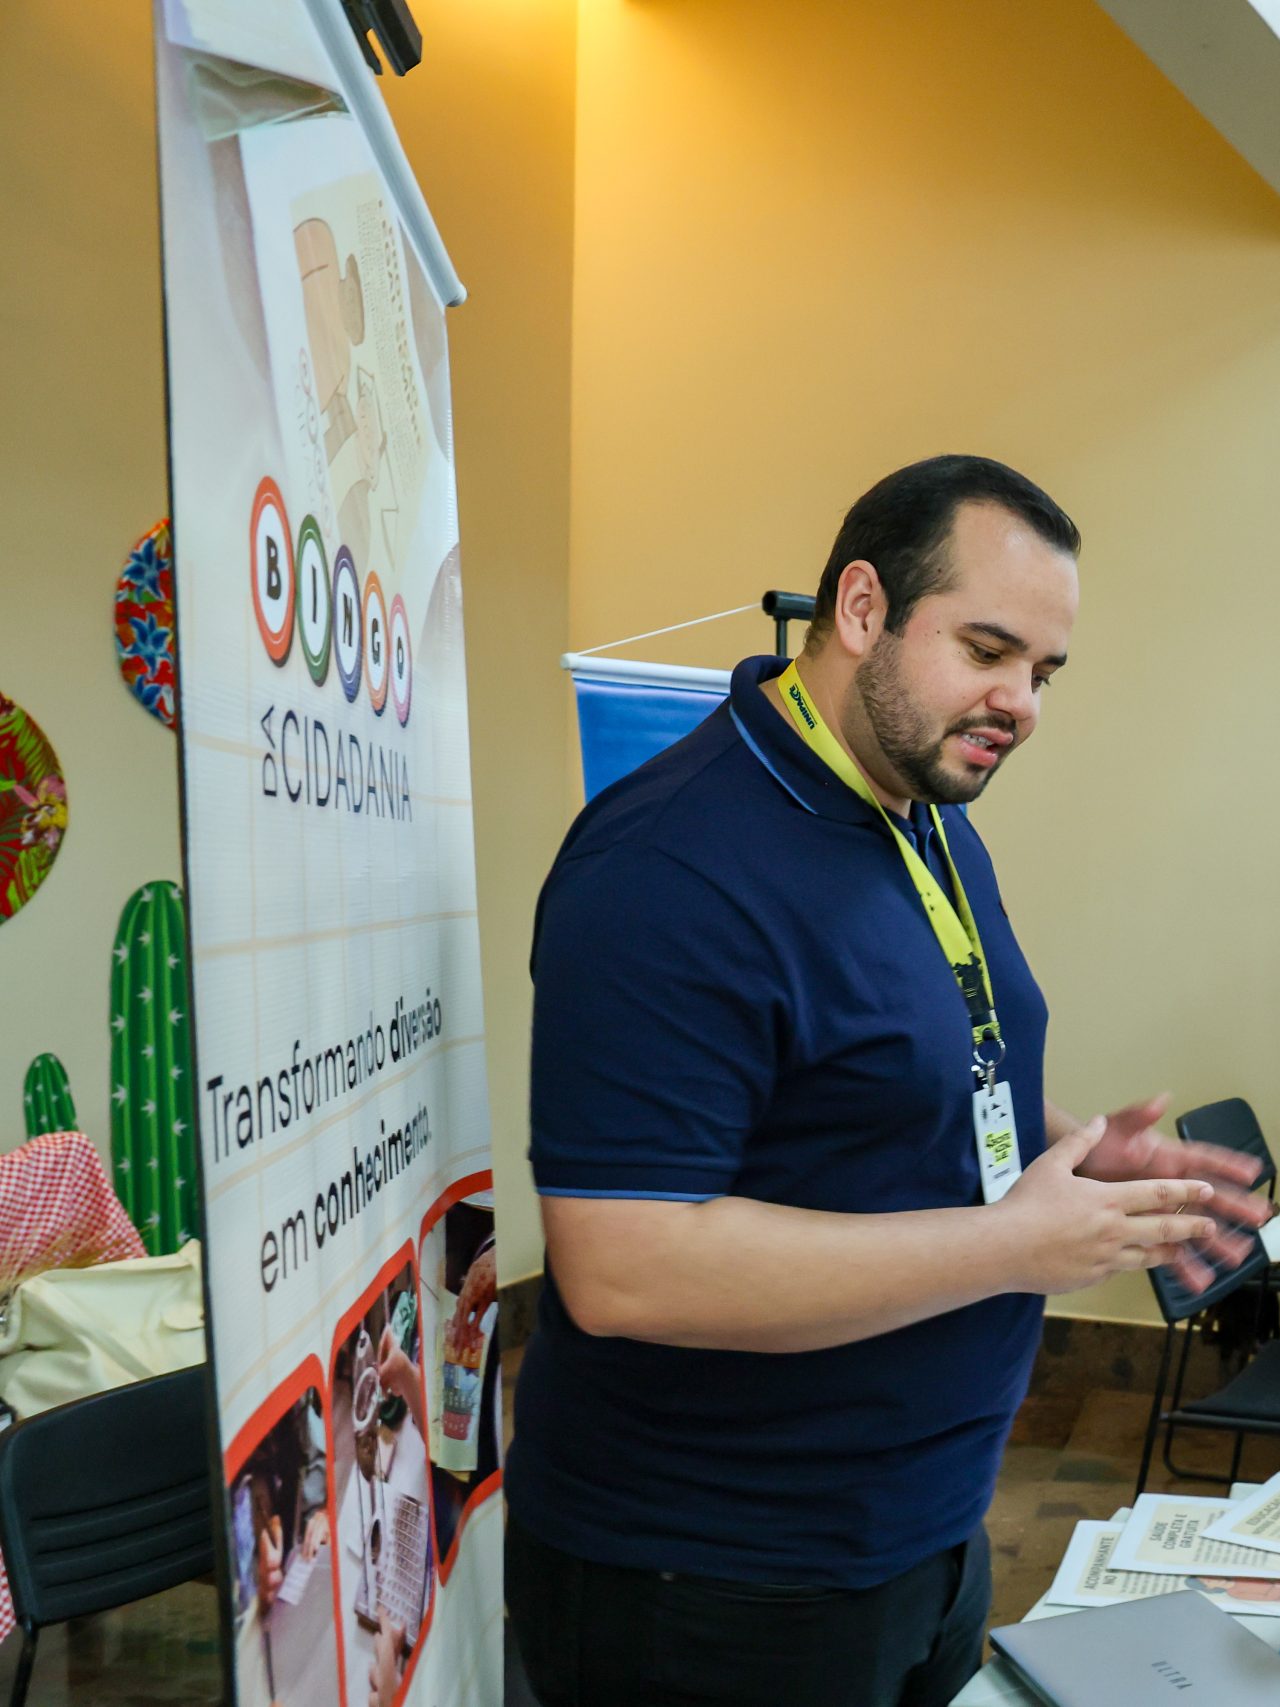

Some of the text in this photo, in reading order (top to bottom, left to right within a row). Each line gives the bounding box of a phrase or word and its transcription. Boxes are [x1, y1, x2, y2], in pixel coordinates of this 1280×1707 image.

[262, 525, 407, 688] BINGO
[260, 705, 278, 798] DA
[281, 709, 413, 822] CIDADANIA
[207, 988, 443, 1163] Transformando diversão
[260, 1209, 309, 1293] em
[1084, 1536, 1115, 1590] ACOMPANHANTE
[1162, 1519, 1183, 1550] COMPLETA
[1179, 1519, 1200, 1548] GRATUITA
[1102, 1575, 1118, 1585] NO
[1151, 1659, 1193, 1690] ULTRA
